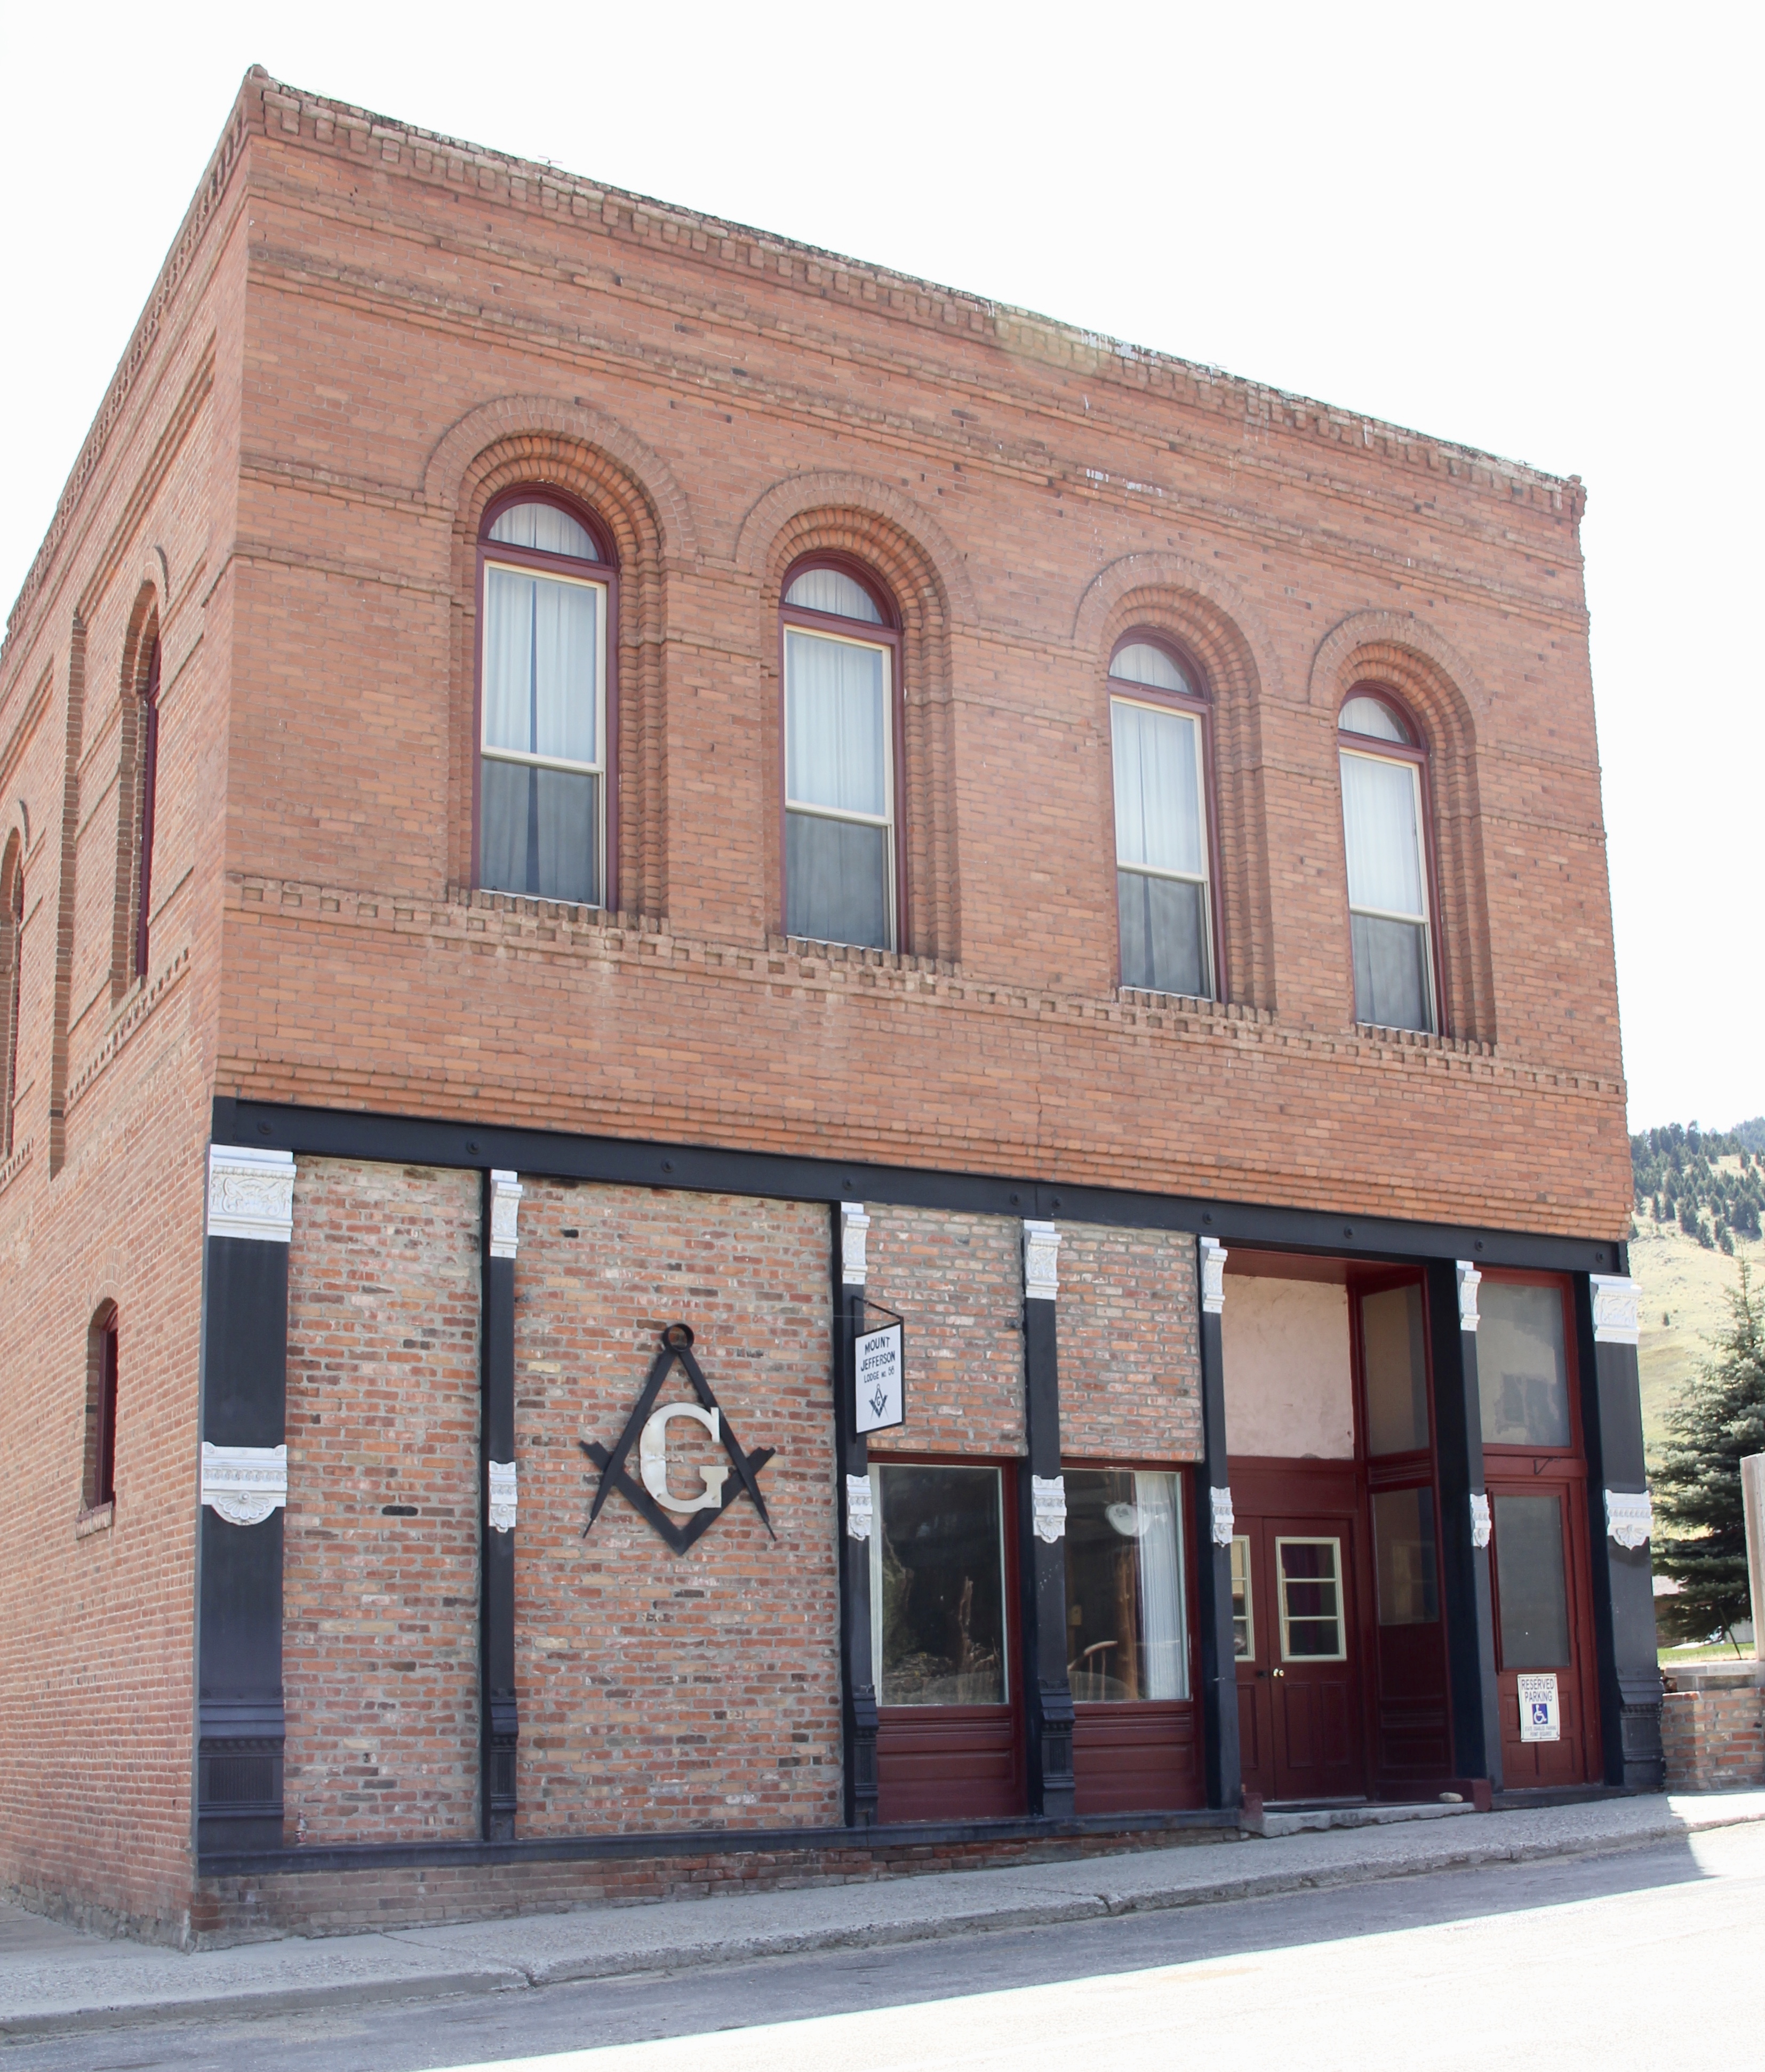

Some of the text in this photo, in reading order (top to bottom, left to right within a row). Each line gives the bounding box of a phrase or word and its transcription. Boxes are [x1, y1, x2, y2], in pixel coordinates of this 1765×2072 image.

[865, 1337, 890, 1355] MOUNT
[861, 1351, 895, 1371] JEFFERSON
[864, 1371, 879, 1383] LODGE
[876, 1396, 881, 1406] G
[640, 1402, 728, 1513] G
[1521, 1678, 1554, 1690] RESERVED
[1525, 1691, 1552, 1702] PARKING
